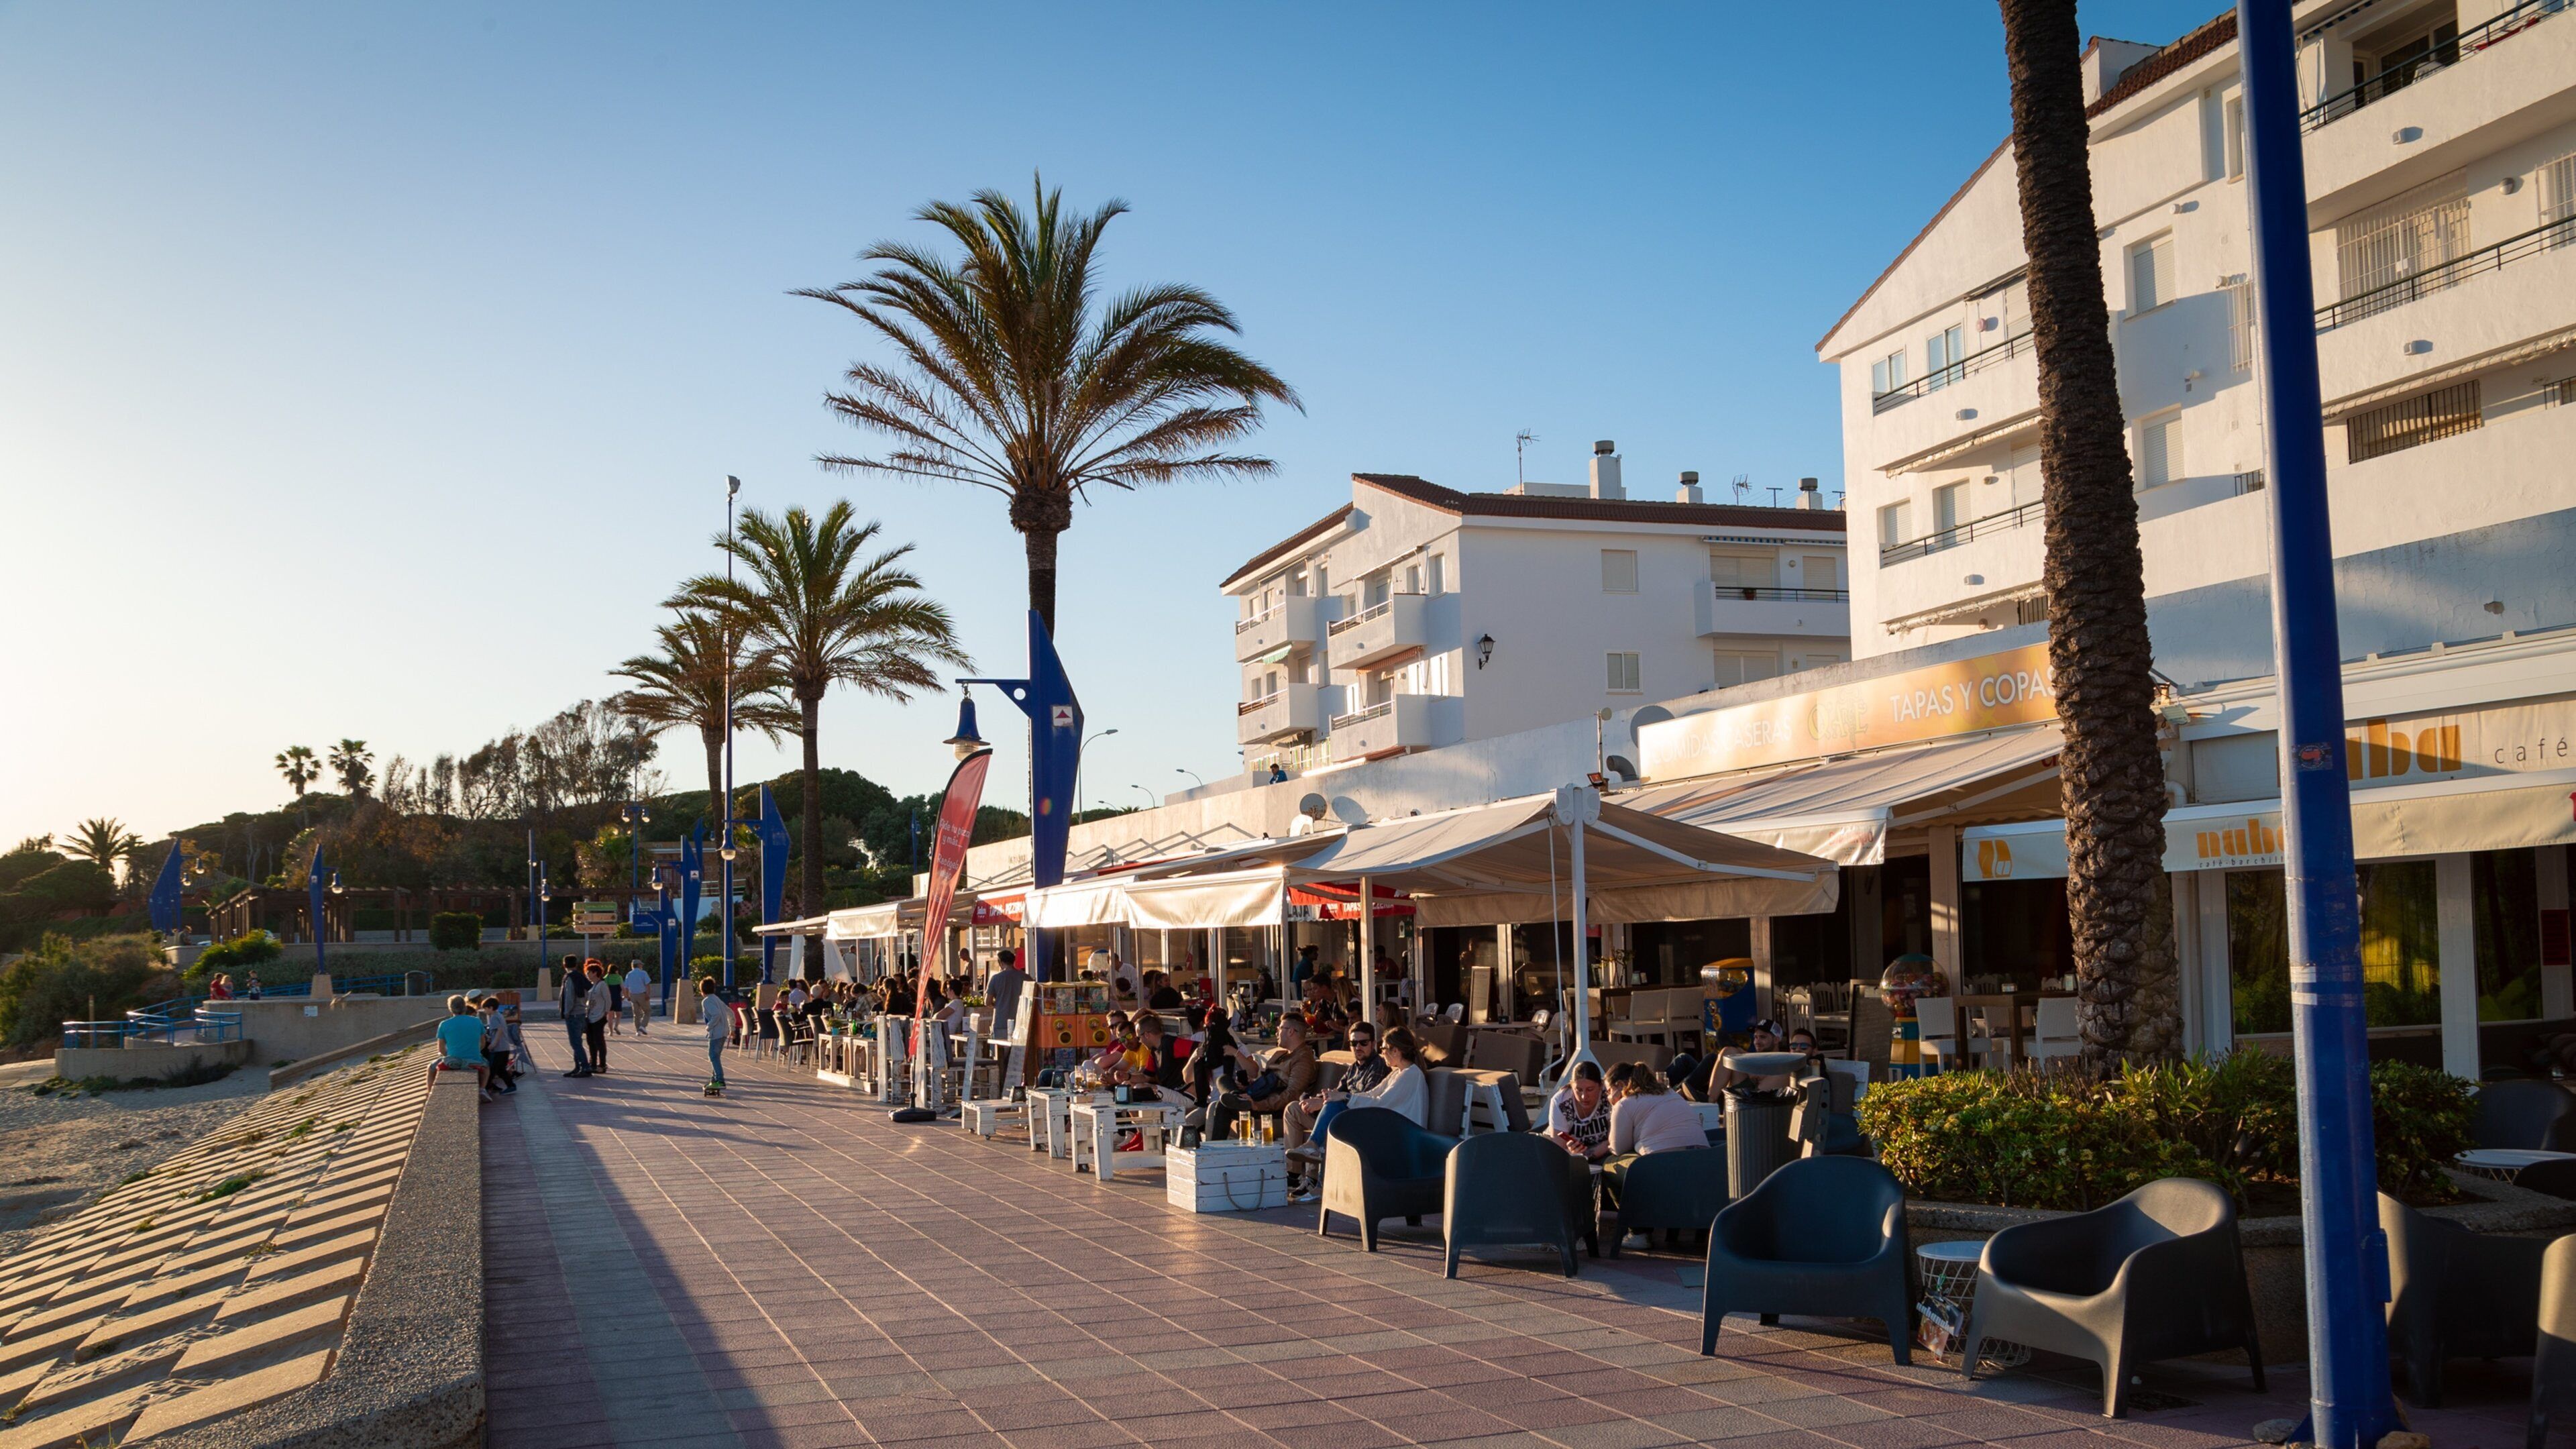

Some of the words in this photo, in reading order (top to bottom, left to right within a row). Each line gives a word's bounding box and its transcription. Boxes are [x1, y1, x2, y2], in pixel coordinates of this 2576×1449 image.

[1890, 685, 1953, 722] TAPAS
[1959, 681, 1972, 710] Y
[1652, 729, 1719, 764] COMIDAS
[1725, 714, 1792, 750] CASERAS
[2494, 737, 2568, 763] café
[1343, 902, 1361, 912] TAPAS
